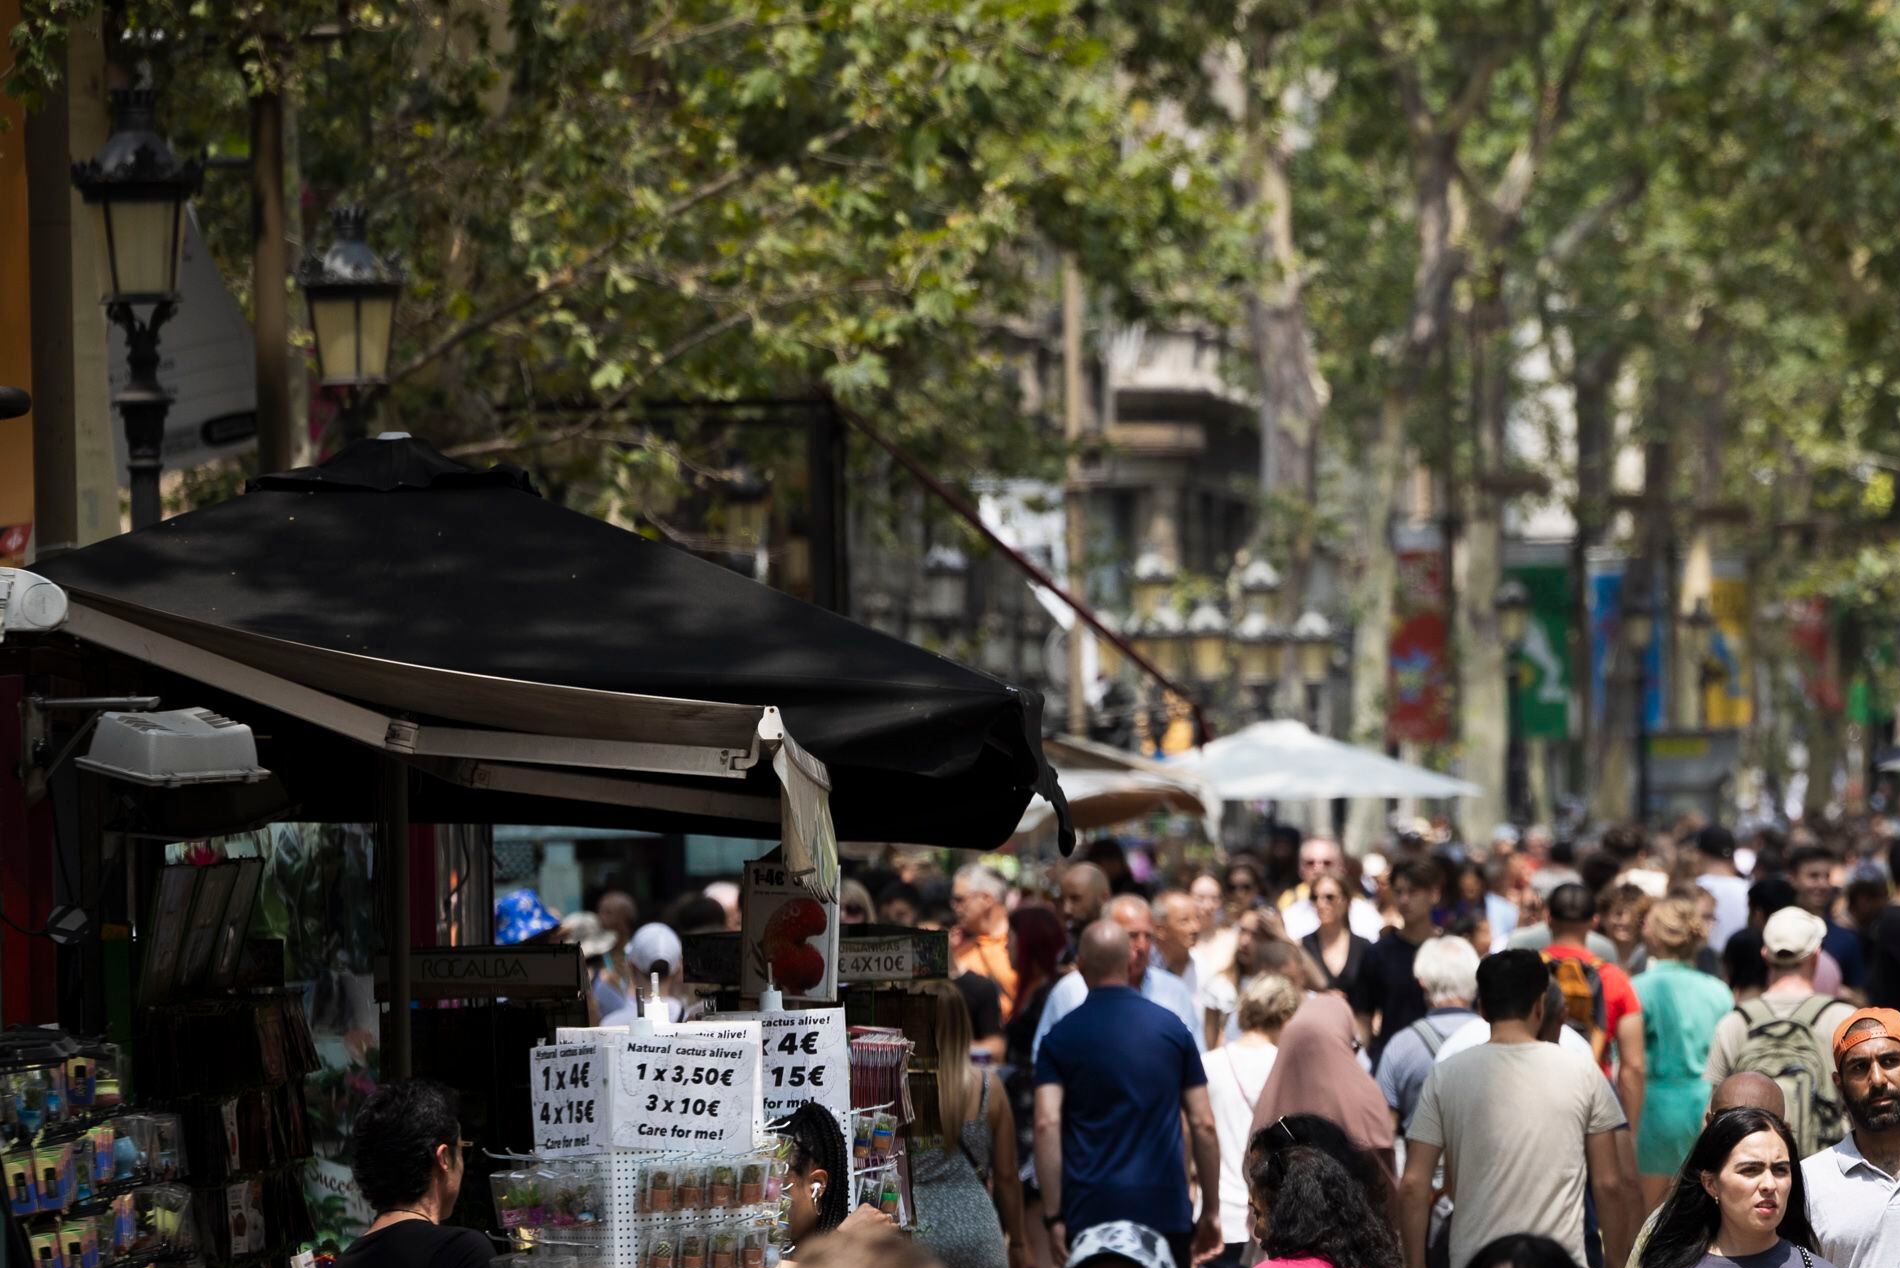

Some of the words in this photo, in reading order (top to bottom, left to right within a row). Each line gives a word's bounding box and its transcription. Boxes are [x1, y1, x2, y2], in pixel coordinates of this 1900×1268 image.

[421, 958, 528, 979] ROCALBA
[851, 956, 905, 972] 4X10€
[762, 1017, 795, 1027] cactus
[798, 1015, 830, 1026] alive!
[718, 1029, 747, 1039] alive!
[777, 1031, 819, 1055] 4€
[627, 1042, 671, 1054] Natural
[676, 1047, 707, 1057] cactus
[709, 1048, 743, 1059] alive!
[542, 1066, 550, 1090] 1
[556, 1071, 566, 1089] x
[570, 1062, 591, 1088] 4€
[637, 1063, 647, 1080] 1
[654, 1068, 667, 1081] x
[674, 1068, 734, 1087] 3,50€
[771, 1065, 826, 1087] 15€
[540, 1102, 550, 1124] 4
[553, 1105, 564, 1124] x
[567, 1099, 595, 1124] 15€
[646, 1095, 658, 1112] 3
[662, 1099, 674, 1113] x
[682, 1097, 721, 1117] 10€
[763, 1097, 783, 1109] for
[638, 1124, 667, 1137] Care
[671, 1125, 691, 1138] for
[693, 1128, 724, 1140] me!
[545, 1135, 562, 1150] Care
[563, 1137, 573, 1149] for
[574, 1135, 590, 1147] me!
